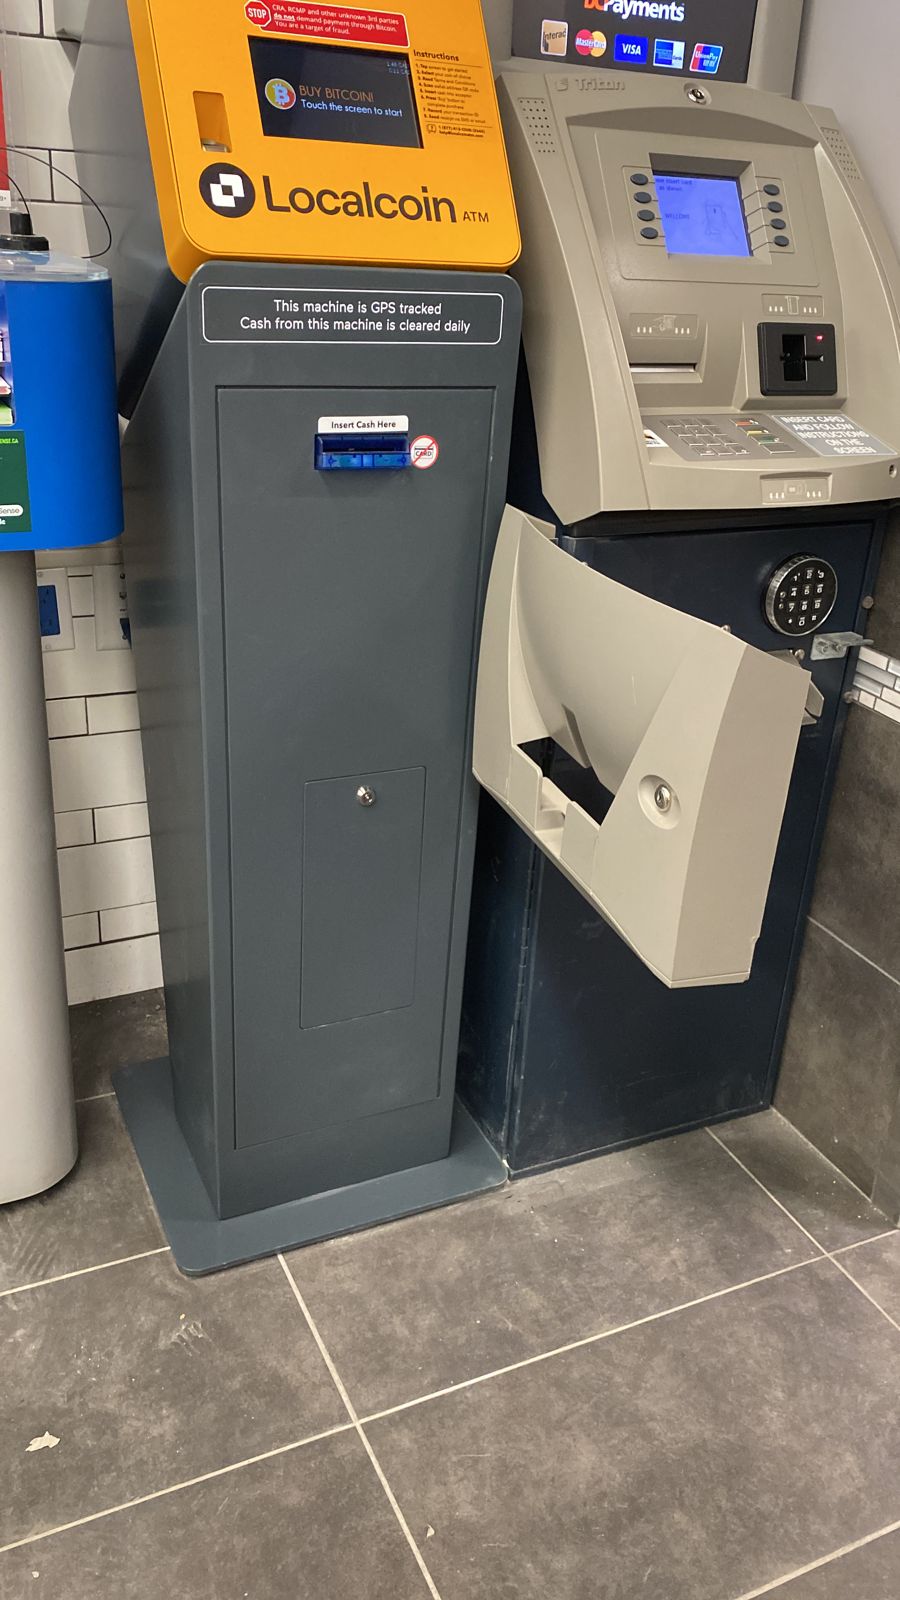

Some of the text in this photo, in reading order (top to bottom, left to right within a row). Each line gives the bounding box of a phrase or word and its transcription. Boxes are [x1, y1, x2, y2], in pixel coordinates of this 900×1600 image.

[248, 9, 267, 19] STOP
[338, 12, 367, 21] unknown
[368, 14, 378, 22] 3rd
[379, 16, 400, 26] parties
[296, 15, 322, 24] demand
[324, 18, 350, 28] payment
[350, 20, 376, 30] through
[376, 24, 398, 32] Bitcoin.
[305, 24, 324, 32] target
[332, 27, 350, 35] fraud.
[575, 37, 607, 49] MasterCard
[622, 43, 642, 56] VISA
[414, 50, 460, 62] Instructions
[694, 49, 719, 62] UnionPay
[575, 78, 626, 92] Triton
[299, 84, 375, 103] BUY BITCOIN!
[300, 98, 403, 117] Touch the screen to start
[262, 174, 490, 223] Localcoin ATM
[274, 300, 442, 316] This machine is GPS tracked
[240, 316, 470, 334] Cash from this machine is cleared daily
[332, 420, 396, 430] Insert Cash Here
[796, 430, 870, 438] INSTRUCTIONS
